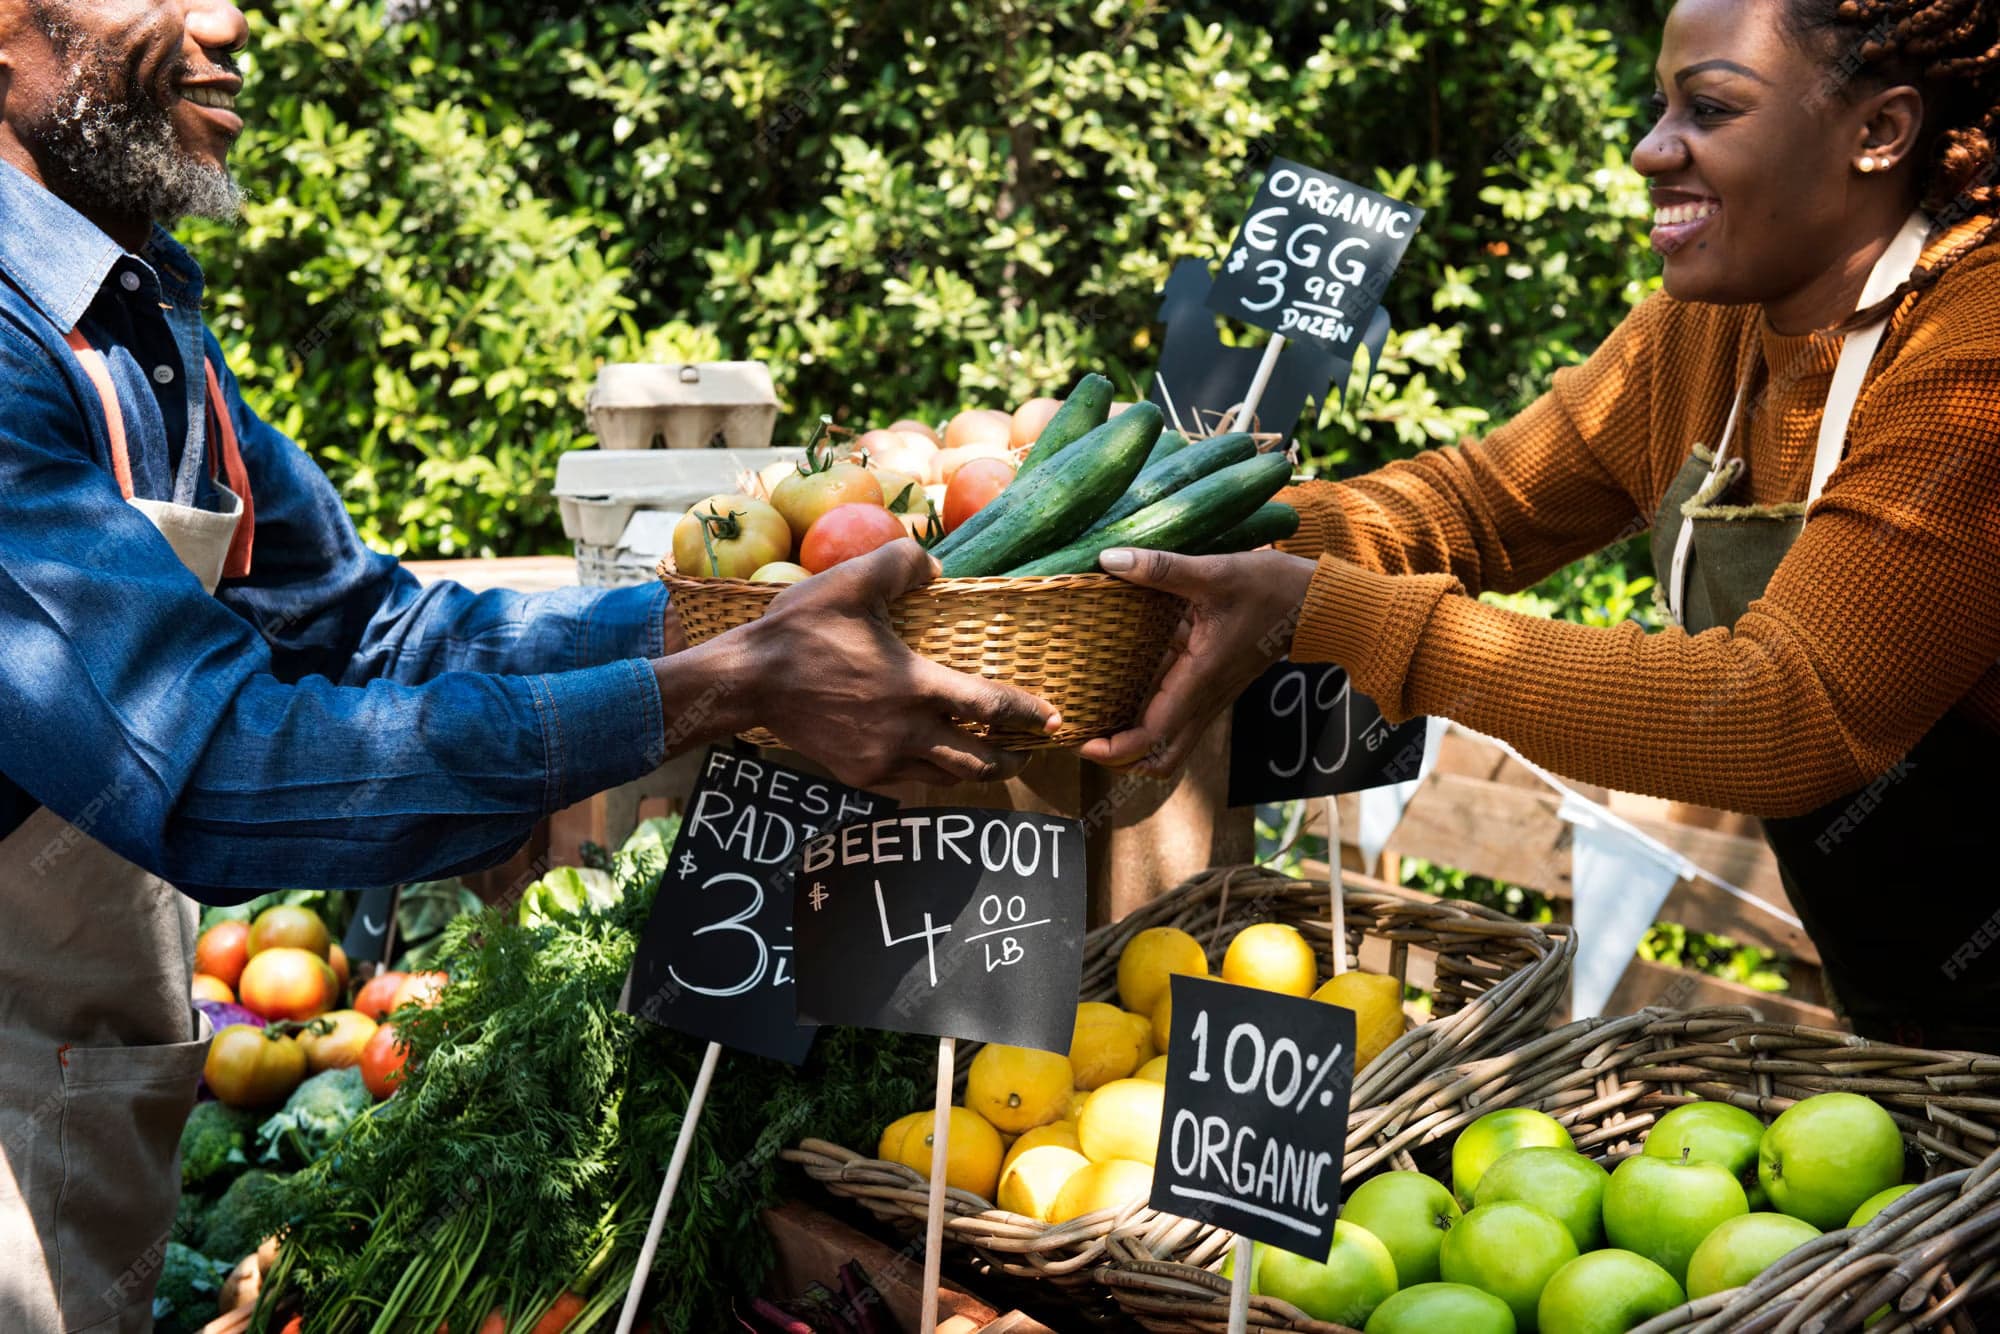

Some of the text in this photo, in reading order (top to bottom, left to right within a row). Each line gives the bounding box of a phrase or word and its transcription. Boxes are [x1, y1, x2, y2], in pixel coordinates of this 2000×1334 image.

[1269, 169, 1411, 239] ORGANIC
[1244, 207, 1370, 286] EGG
[1304, 276, 1345, 307] 99
[1277, 308, 1354, 343] DOZEN
[706, 752, 873, 821] FRESH
[803, 814, 1066, 878] BEETROOT
[979, 895, 1026, 925] 00
[985, 937, 1024, 972] LB
[1189, 1010, 1342, 1114] 100%
[1171, 1108, 1333, 1216] ORGANIC
